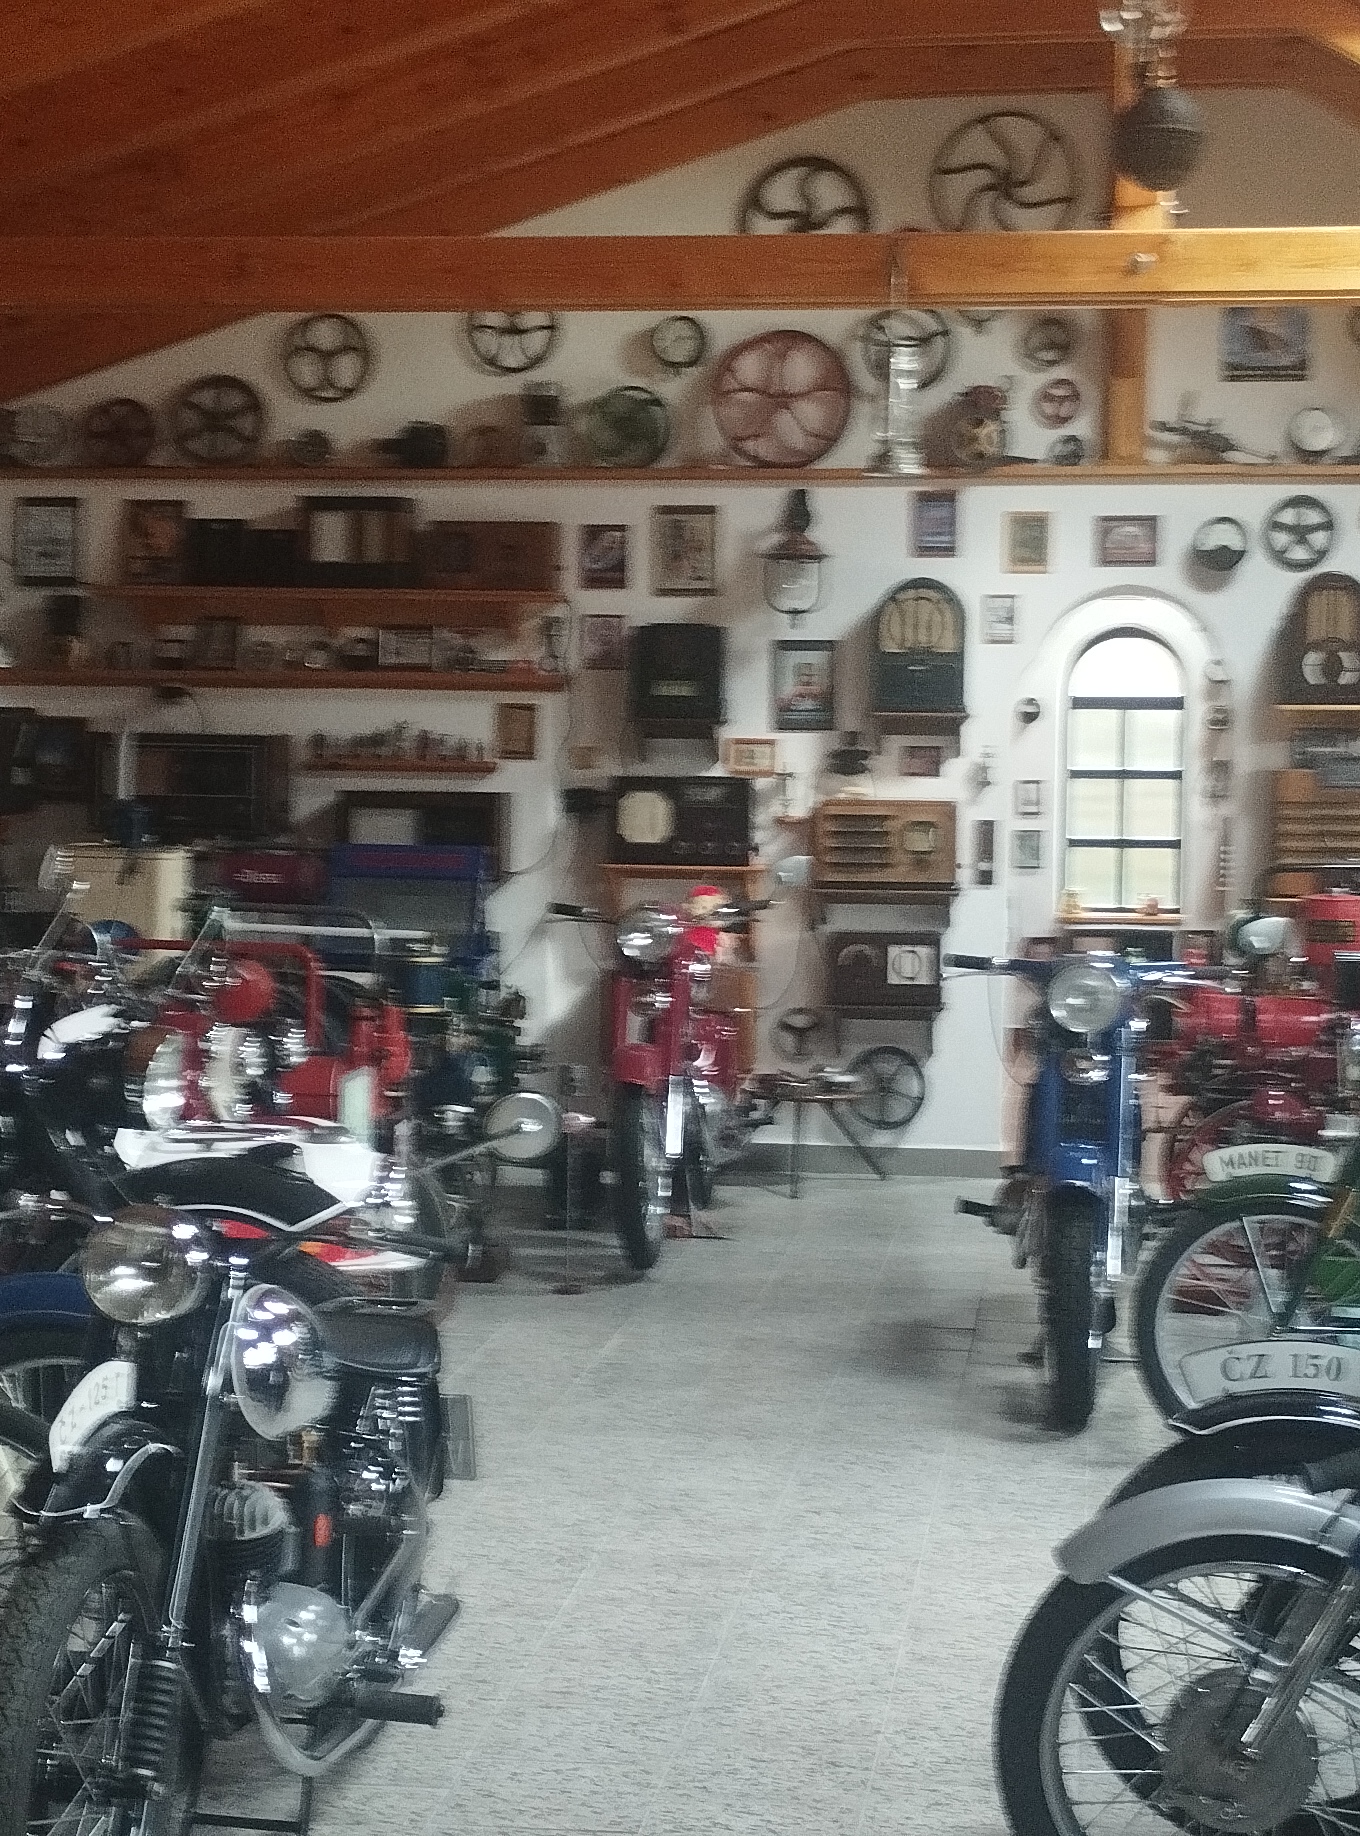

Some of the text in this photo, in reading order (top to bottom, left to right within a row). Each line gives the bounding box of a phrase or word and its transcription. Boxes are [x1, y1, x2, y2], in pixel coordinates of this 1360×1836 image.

[1219, 1149, 1287, 1173] MANET
[1219, 1349, 1274, 1382] ČZ
[1290, 1353, 1344, 1382] 150
